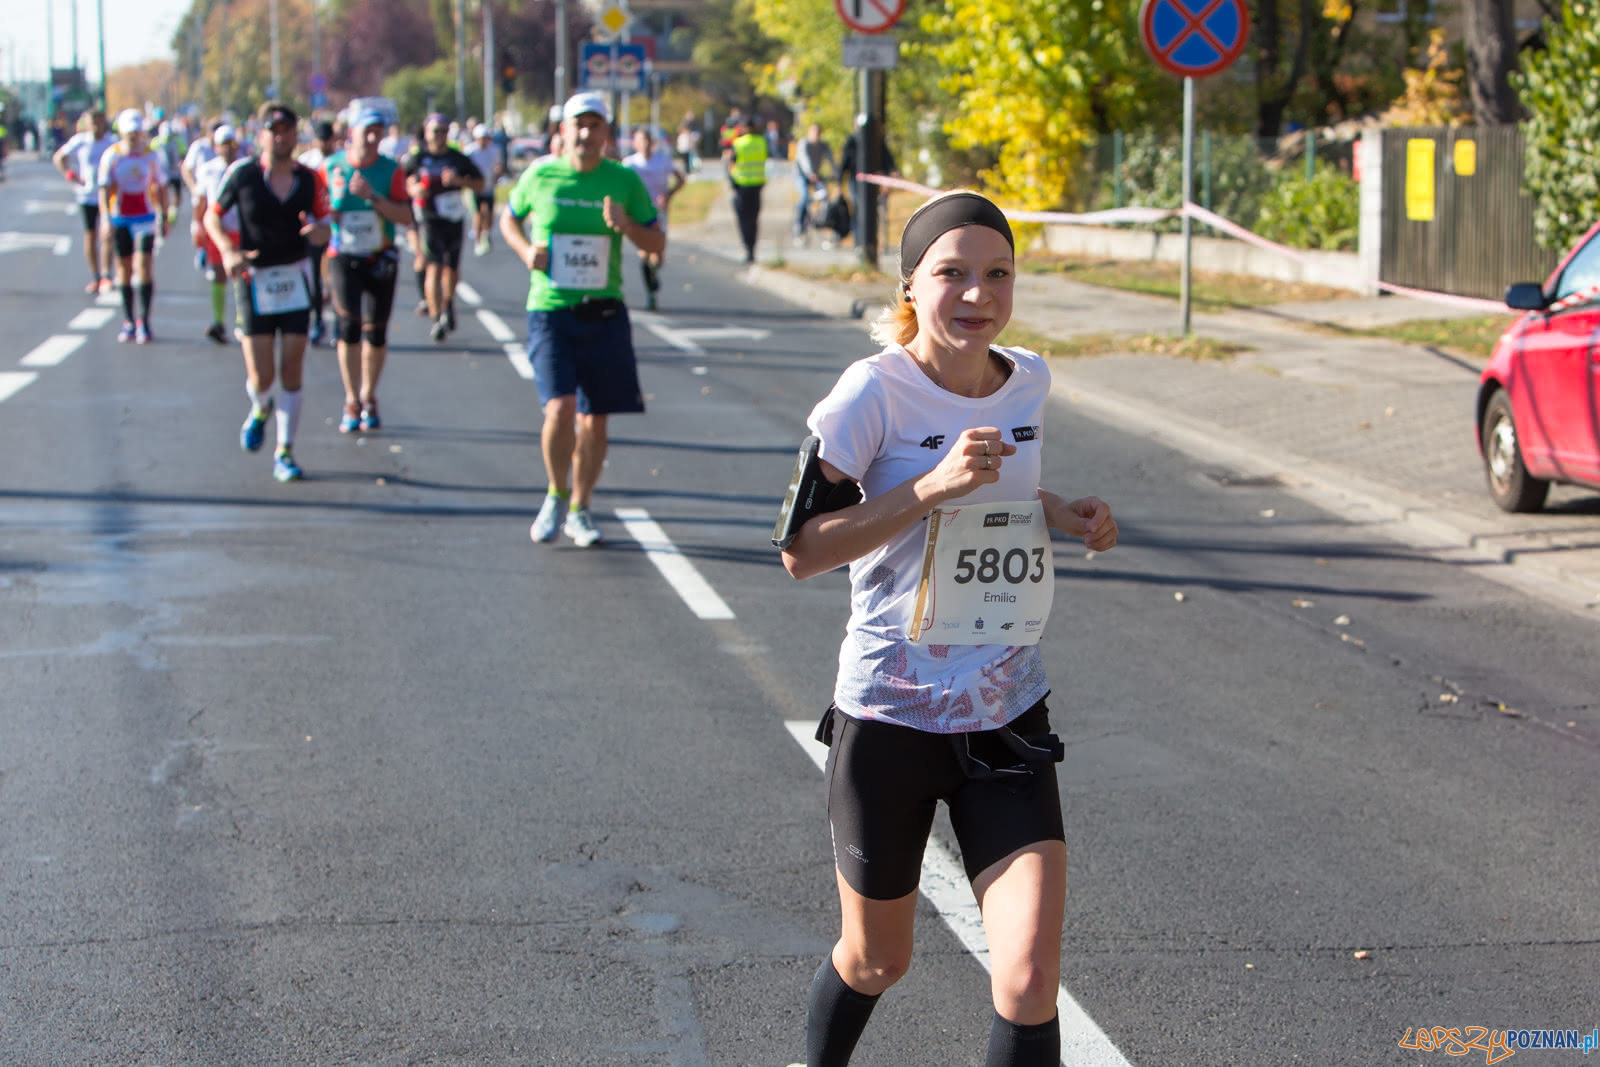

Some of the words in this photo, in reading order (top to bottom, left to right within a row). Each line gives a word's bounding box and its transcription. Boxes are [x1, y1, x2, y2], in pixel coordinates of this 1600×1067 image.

[920, 435, 945, 449] 4F
[953, 547, 1045, 584] 5803
[983, 591, 1017, 603] Emilia
